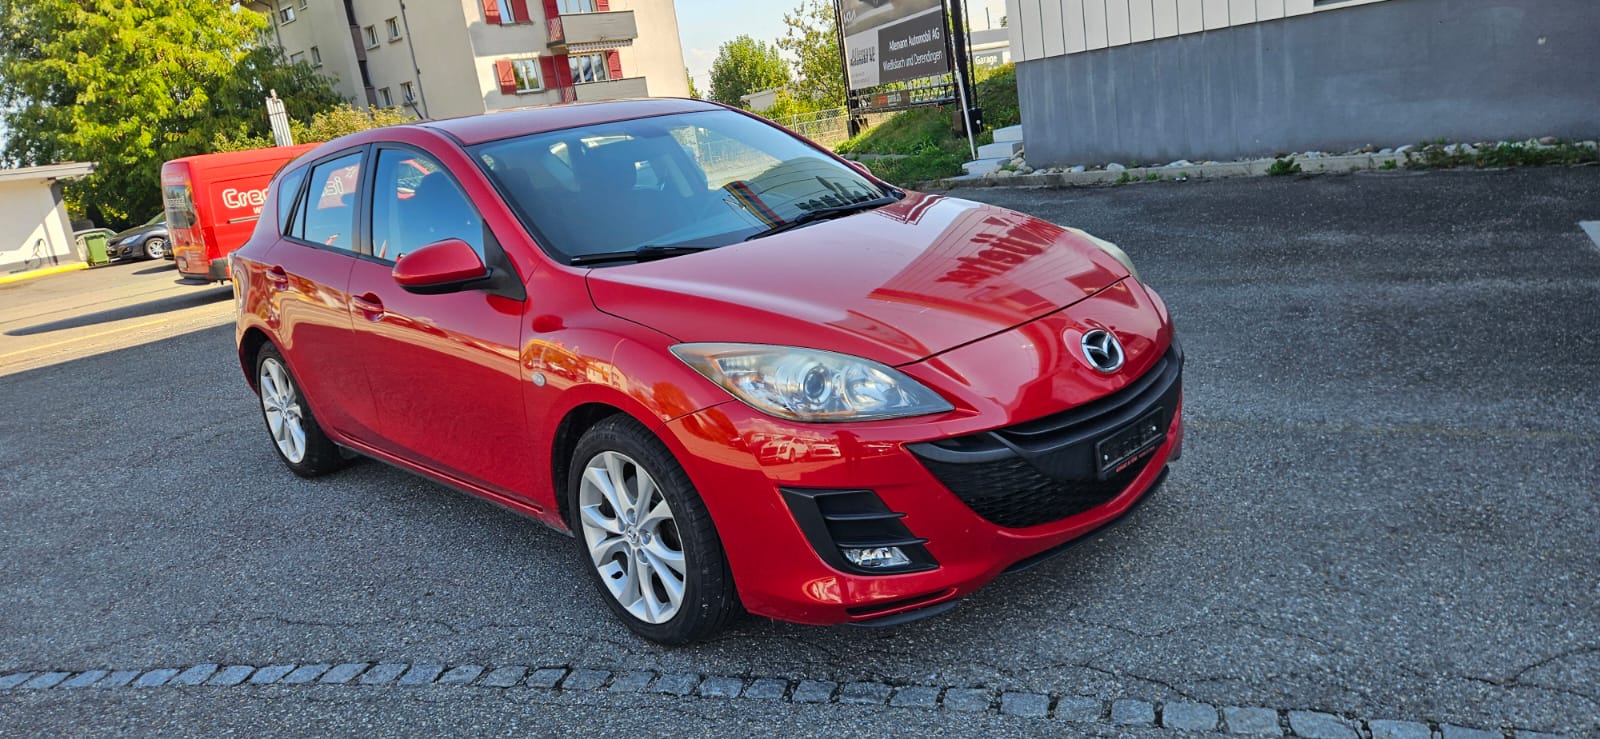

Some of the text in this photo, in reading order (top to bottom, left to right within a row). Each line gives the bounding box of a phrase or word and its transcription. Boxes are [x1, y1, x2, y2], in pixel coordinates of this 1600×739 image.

[908, 31, 931, 46] Automobil
[932, 27, 940, 40] AG
[913, 50, 942, 65] Derendingen
[975, 55, 998, 66] Garage
